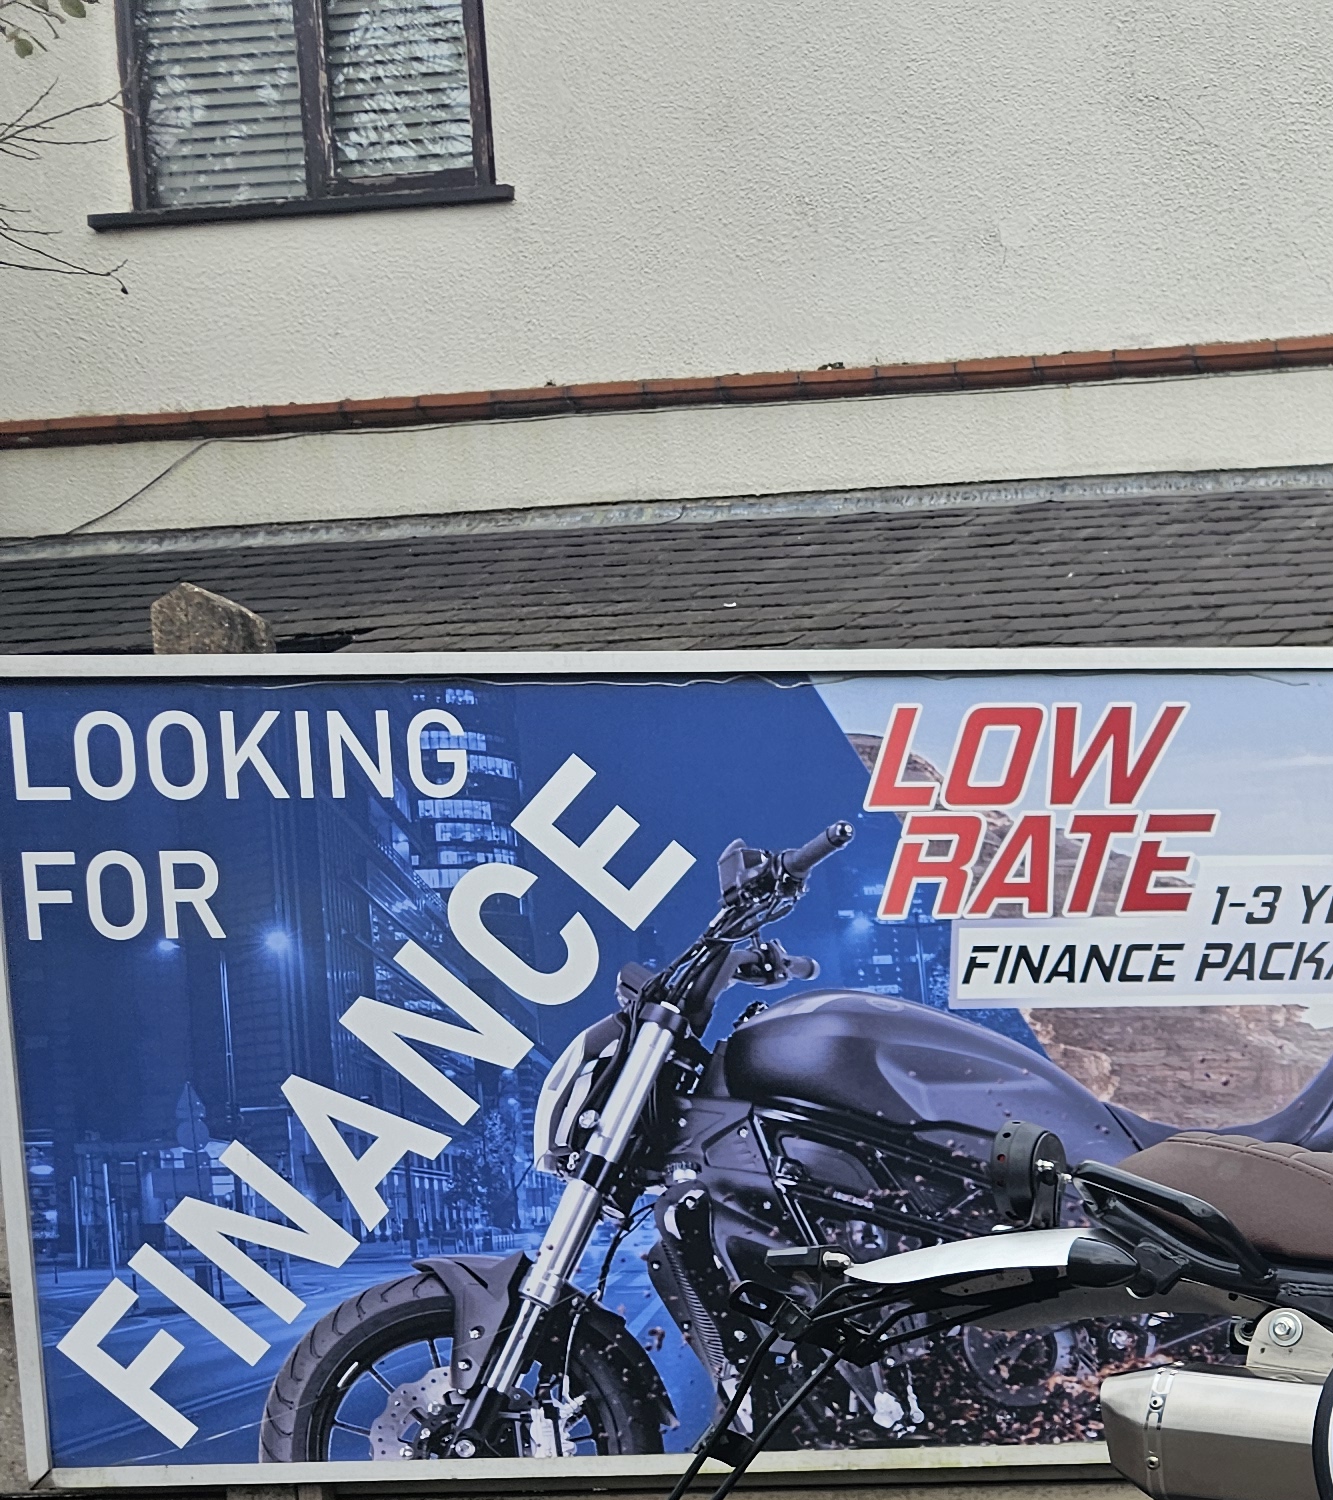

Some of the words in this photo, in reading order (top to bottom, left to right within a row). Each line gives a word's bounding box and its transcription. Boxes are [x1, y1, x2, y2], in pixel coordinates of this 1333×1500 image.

[9, 709, 468, 801] LOOKING
[865, 703, 1190, 808] LOW
[21, 851, 226, 941] FOR
[878, 810, 1220, 918] RATE
[1211, 886, 1282, 926] 1-3
[961, 942, 1185, 985] FINANCE
[56, 753, 697, 1447] FINANCE
